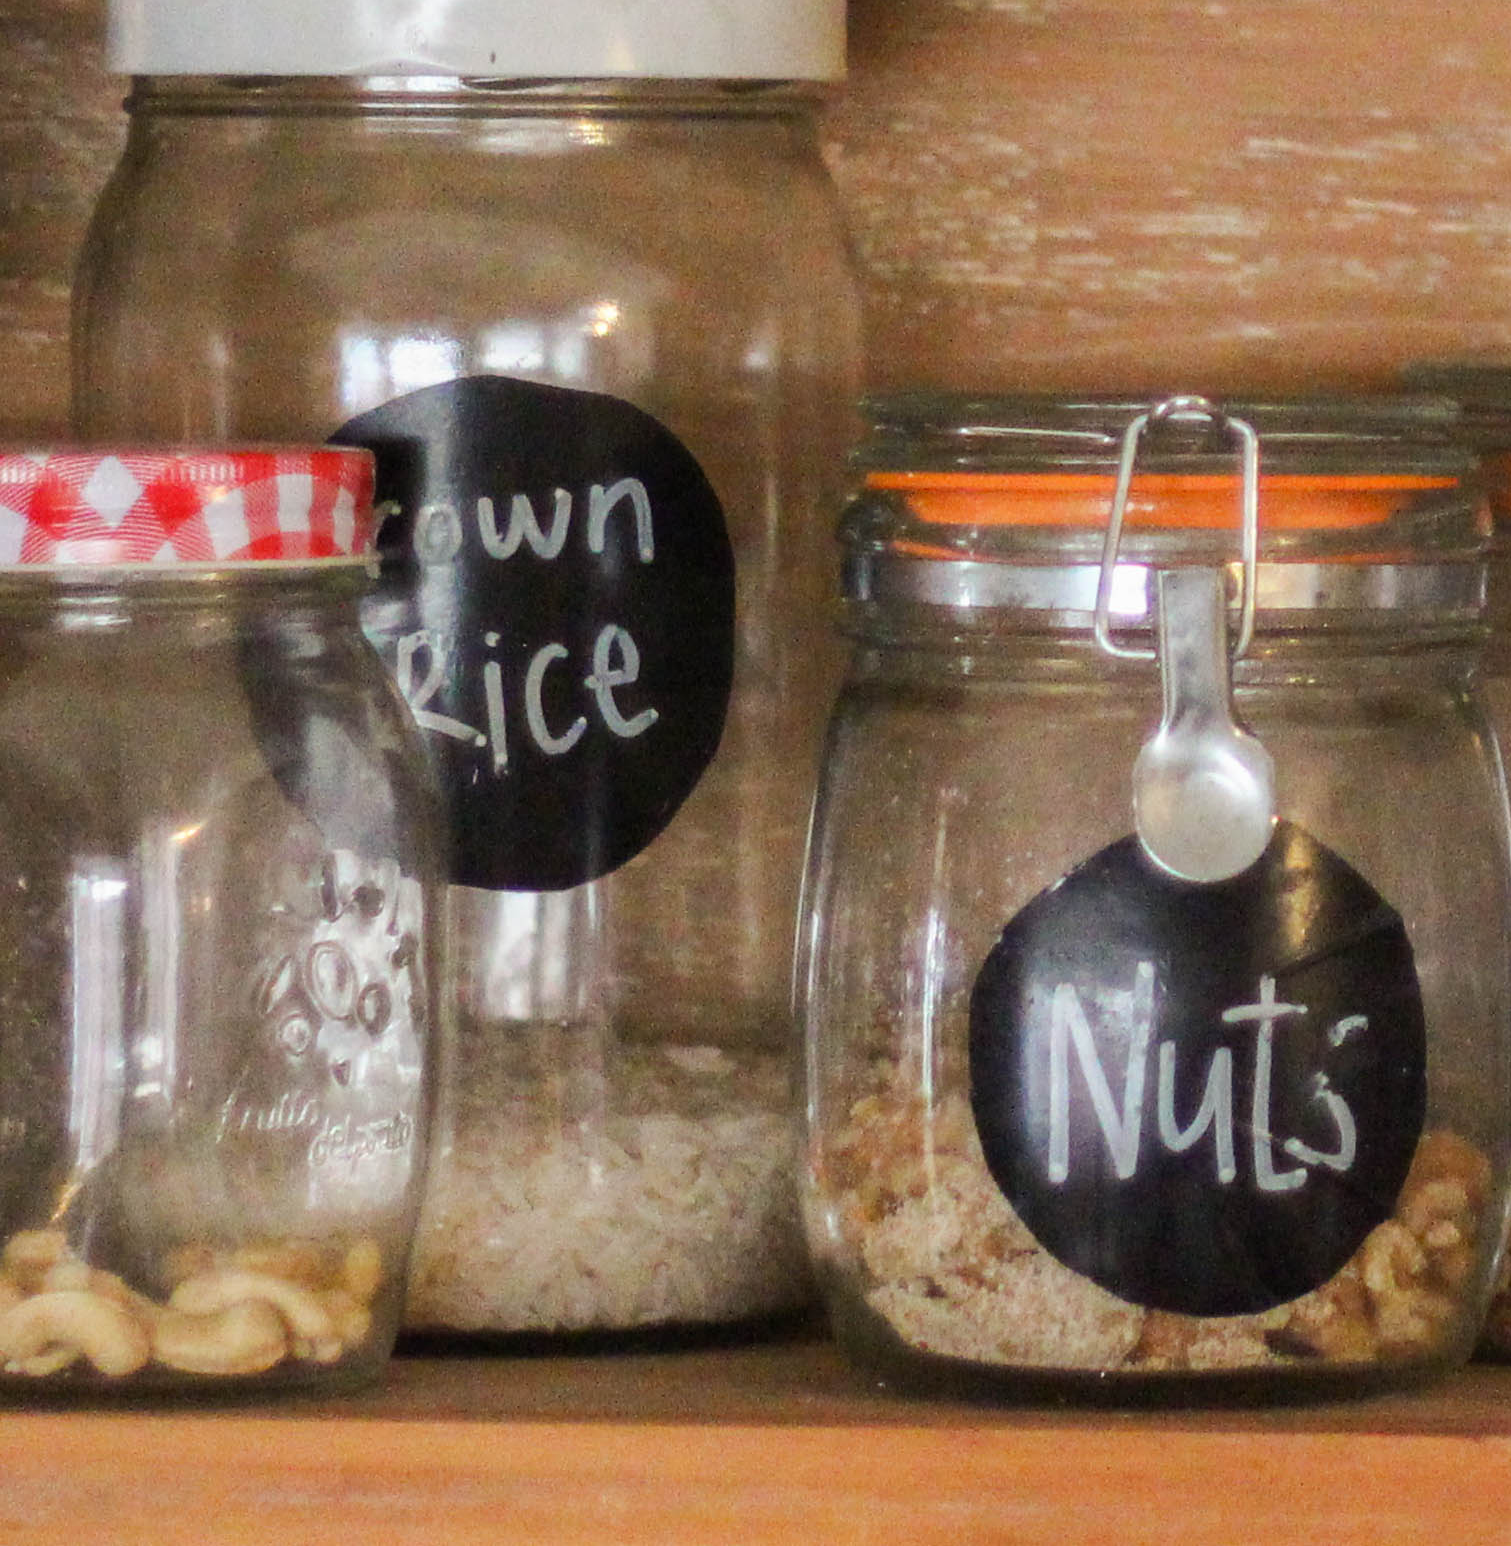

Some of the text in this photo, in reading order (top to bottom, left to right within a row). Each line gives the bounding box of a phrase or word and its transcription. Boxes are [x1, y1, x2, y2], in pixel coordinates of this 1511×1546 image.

[362, 476, 655, 578] rown
[396, 623, 660, 776] Rice
[1047, 959, 1369, 1193] Nuts
